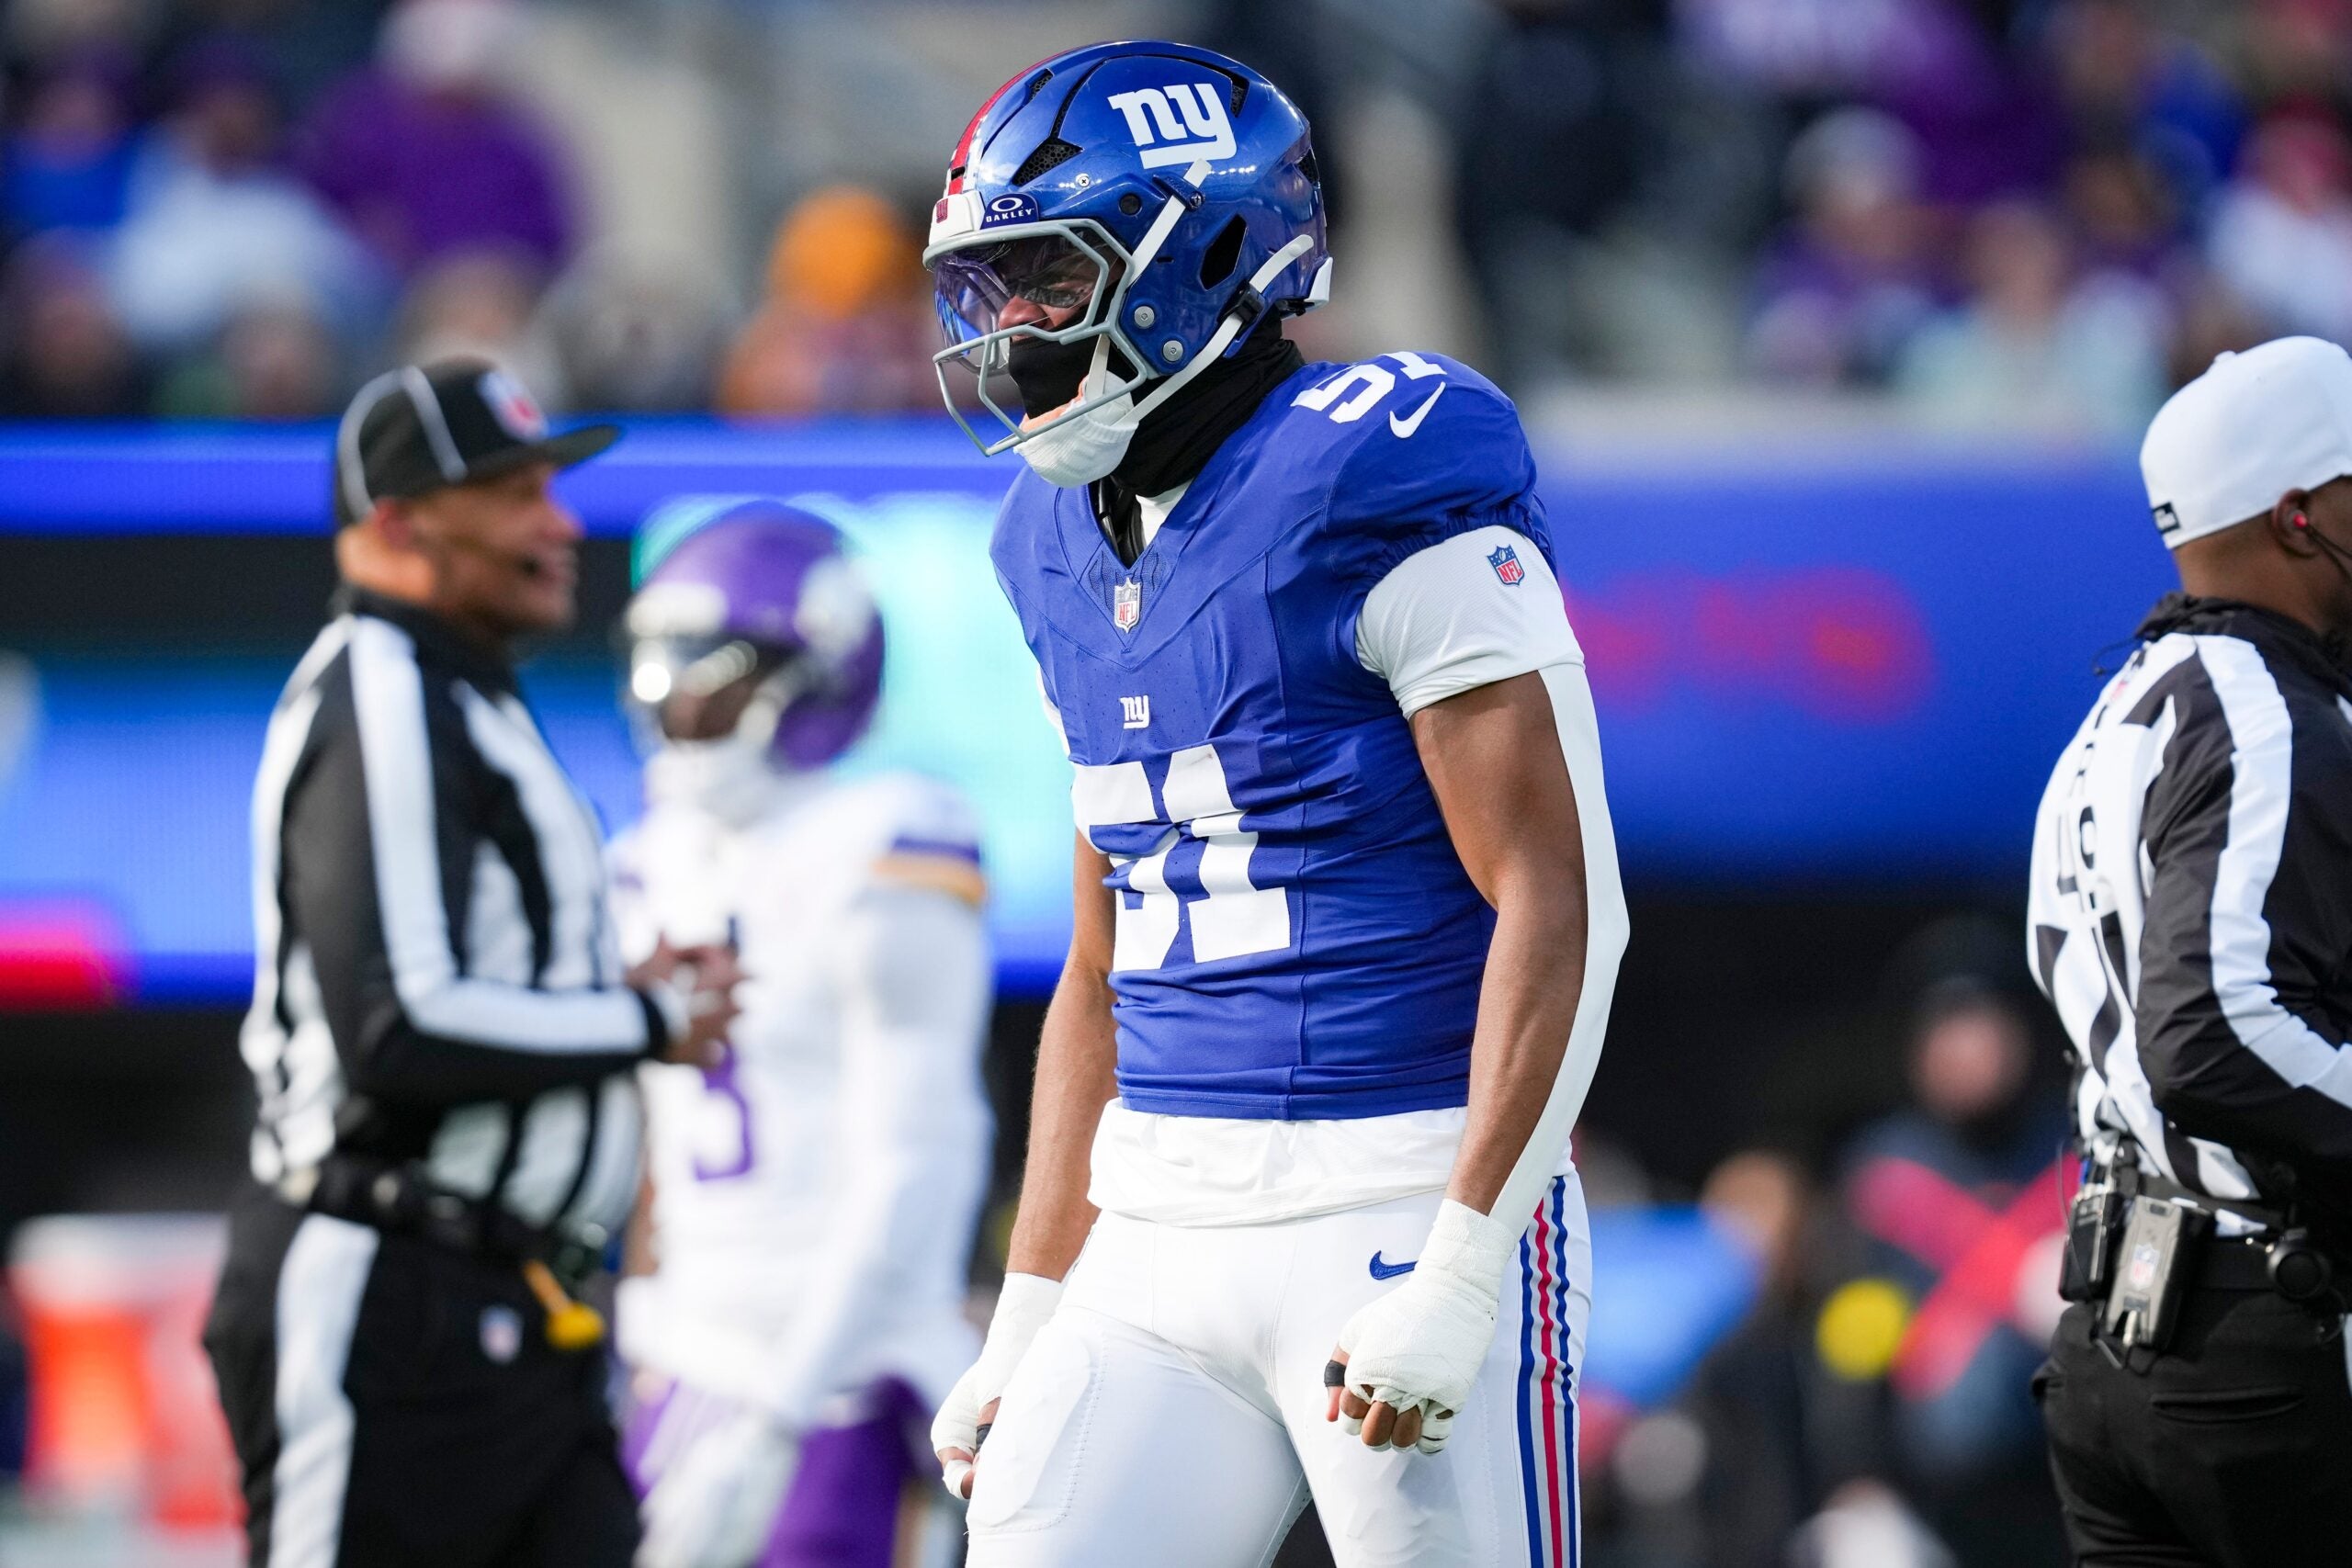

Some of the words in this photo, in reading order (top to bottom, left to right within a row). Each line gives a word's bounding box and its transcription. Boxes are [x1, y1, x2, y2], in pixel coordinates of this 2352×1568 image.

[985, 209, 1033, 223] OAKLEY
[1290, 351, 1448, 424] 51
[1497, 558, 1522, 582] NFL
[1118, 602, 1136, 623] NFL
[1069, 743, 1291, 973] 51
